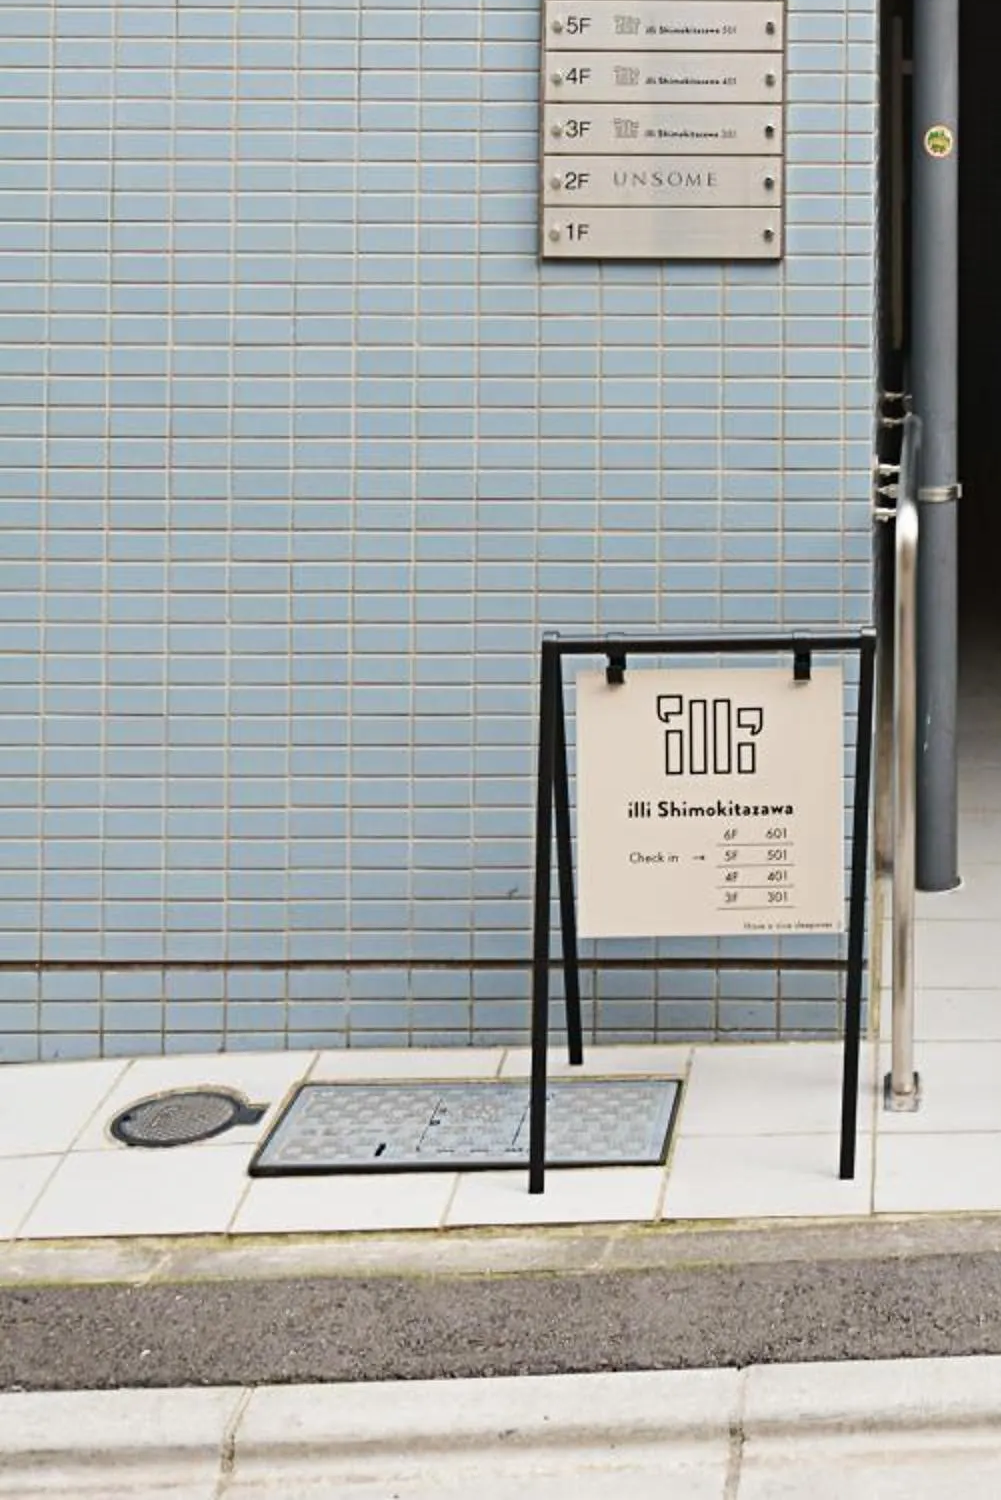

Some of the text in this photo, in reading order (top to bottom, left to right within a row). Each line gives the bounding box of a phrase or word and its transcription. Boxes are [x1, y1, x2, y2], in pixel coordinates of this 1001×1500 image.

[566, 17, 592, 35] 5F
[565, 68, 592, 85] 4F
[565, 120, 592, 138] 3F
[564, 171, 719, 190] 2F UNSOME
[566, 223, 590, 241] 1F
[628, 799, 794, 818] illi Shimokitazawa
[723, 827, 788, 841] 6F 601
[629, 852, 679, 864] Check in
[724, 848, 788, 862] 5F 501
[725, 870, 788, 882] 4F 401
[767, 891, 788, 903] 301
